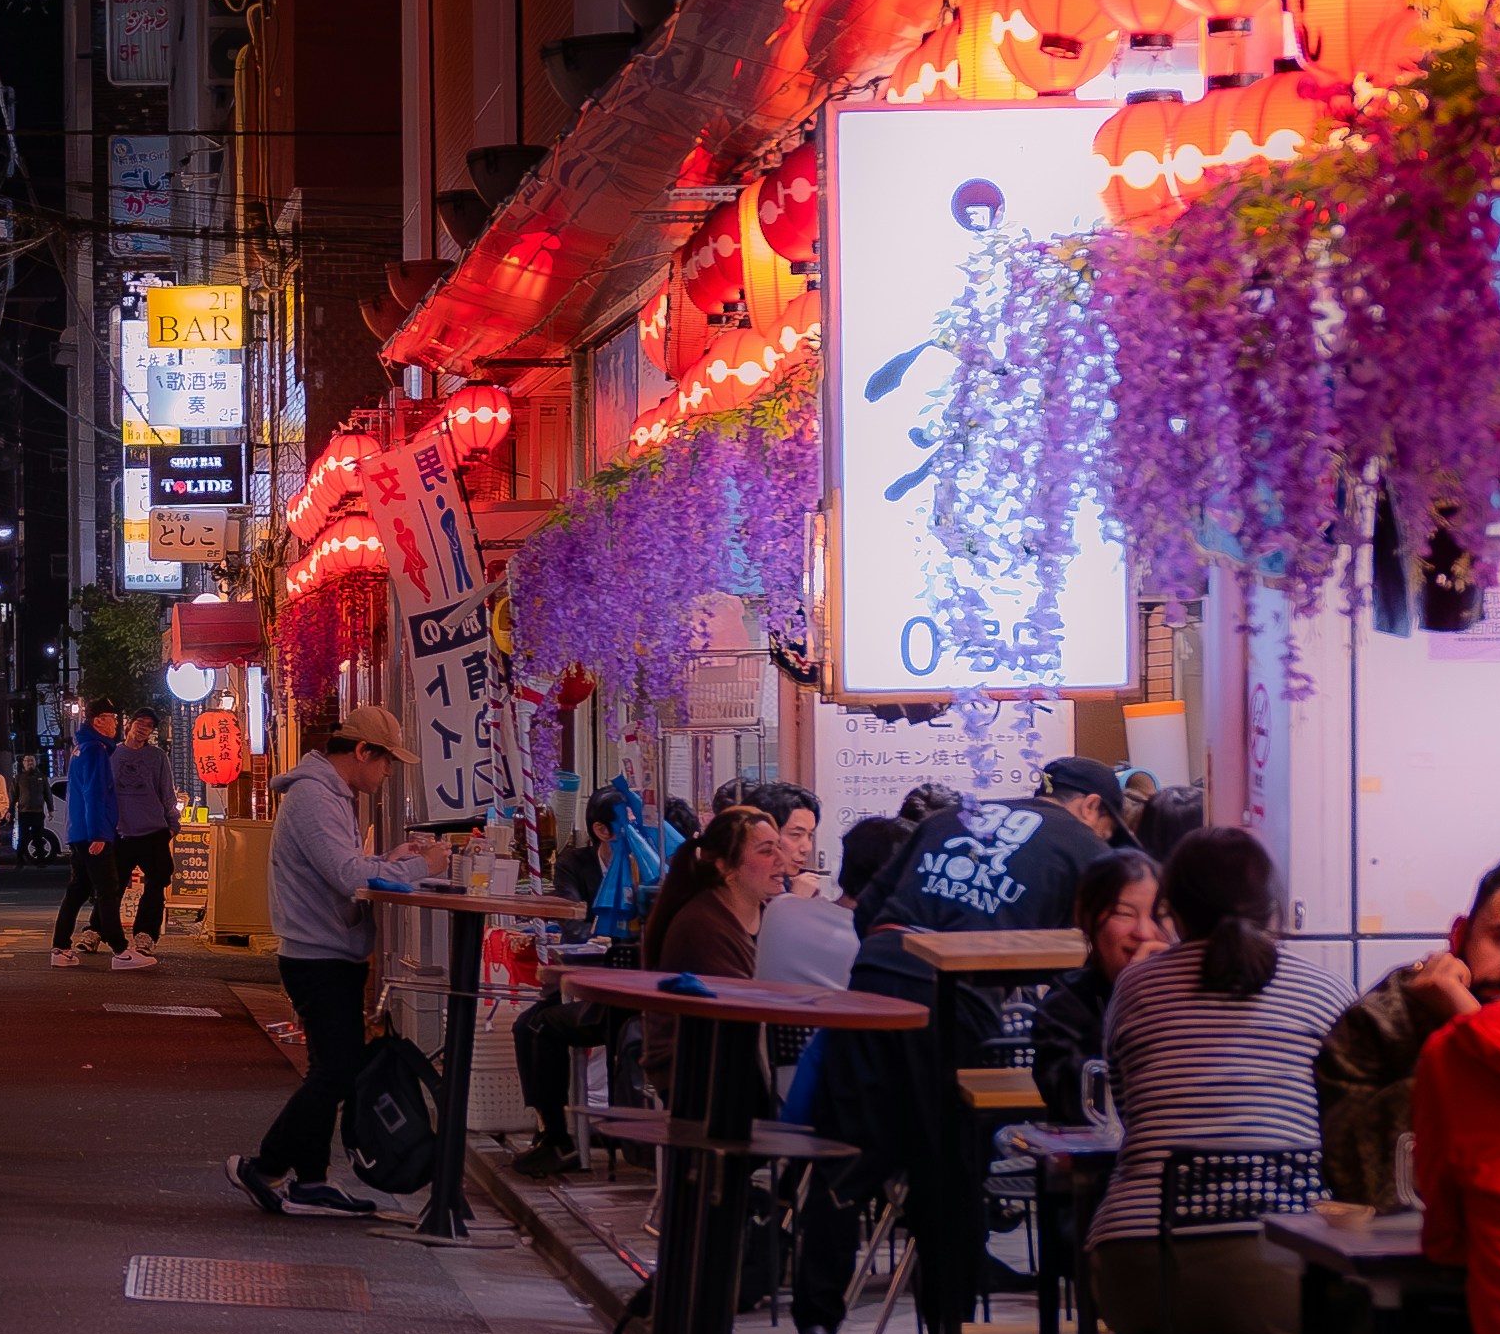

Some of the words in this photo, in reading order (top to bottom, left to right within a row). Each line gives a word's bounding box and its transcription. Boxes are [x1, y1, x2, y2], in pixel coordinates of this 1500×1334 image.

[119, 44, 140, 62] 5F
[209, 292, 235, 310] 2F
[156, 315, 233, 343] BAR
[166, 371, 227, 391] 歌酒場
[187, 396, 206, 415] 奏
[219, 408, 239, 422] 2F
[170, 457, 199, 468] SHOT
[199, 456, 223, 468] BAR
[158, 524, 217, 547] としこ
[206, 549, 220, 558] 2F
[836, 749, 1005, 768] ①ホルモン焼セト
[922, 874, 1001, 915] JAPAN
